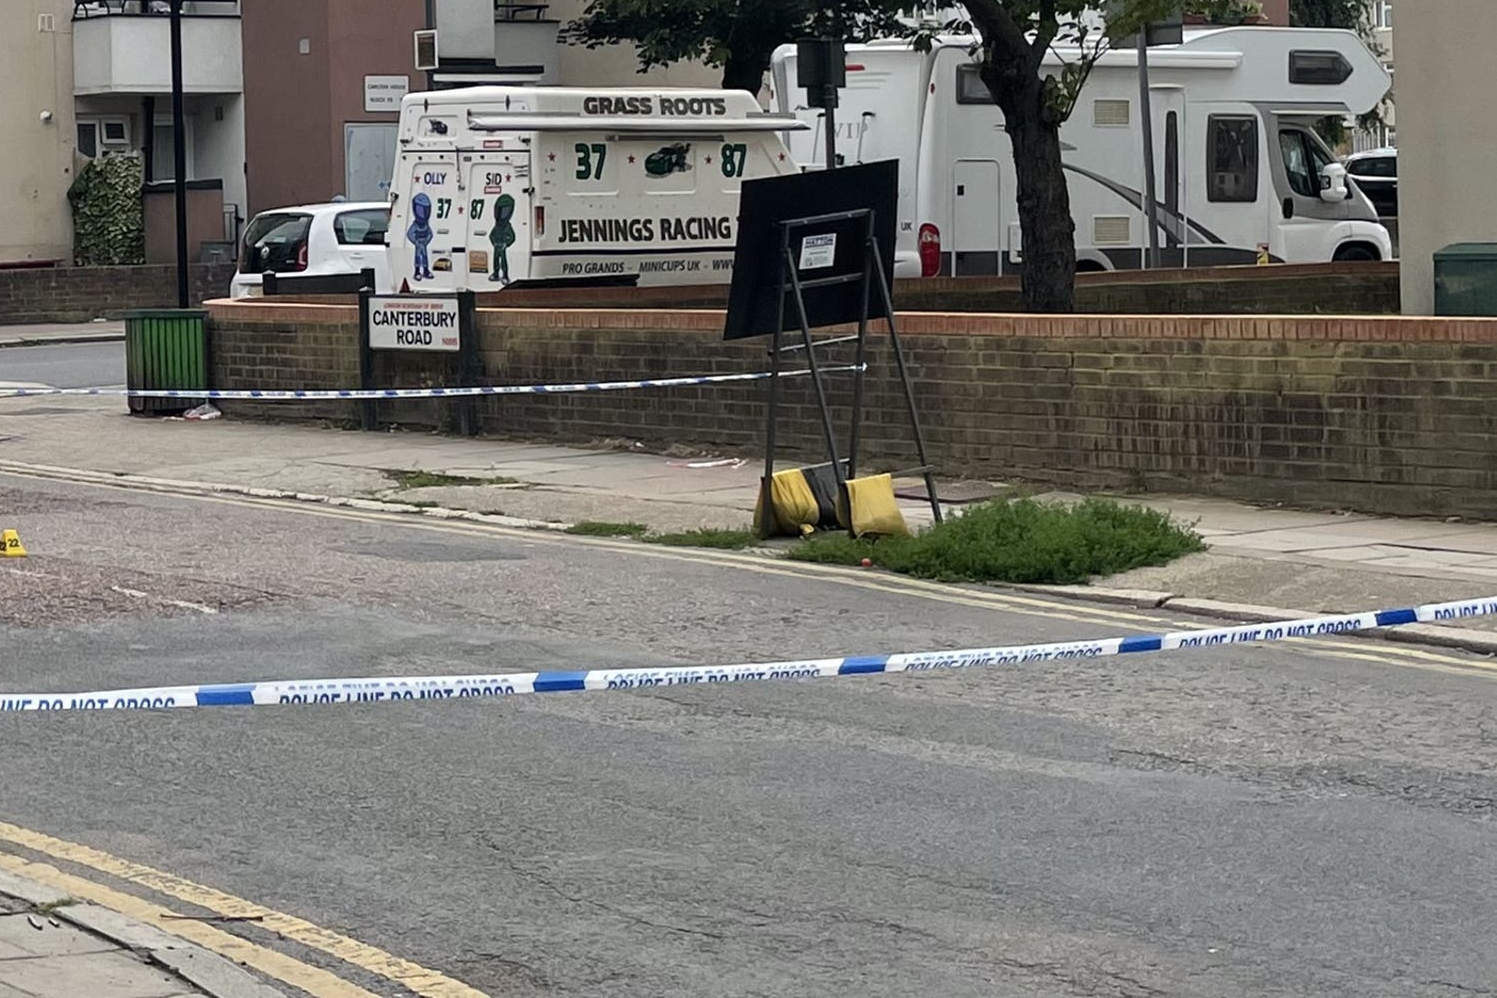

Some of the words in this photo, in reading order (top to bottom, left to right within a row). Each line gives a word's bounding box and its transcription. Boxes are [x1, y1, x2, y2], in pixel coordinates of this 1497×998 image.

[583, 96, 652, 115] GRASS
[660, 97, 726, 116] ROOTS
[574, 143, 607, 181] 37
[721, 143, 747, 178] 87
[423, 172, 447, 185] OLLY
[485, 172, 502, 186] SID
[436, 198, 452, 219] 37
[470, 198, 485, 220] 87
[558, 218, 654, 243] JENNINGS
[660, 216, 732, 240] RACING
[900, 221, 912, 231] UK
[562, 263, 583, 274] PRO
[584, 261, 625, 274] GRANDS
[638, 260, 685, 273] MINICUPS
[686, 260, 701, 272] UK
[372, 310, 457, 328] CANTERBURY
[396, 329, 433, 345] ROAD
[7, 538, 20, 548] 22
